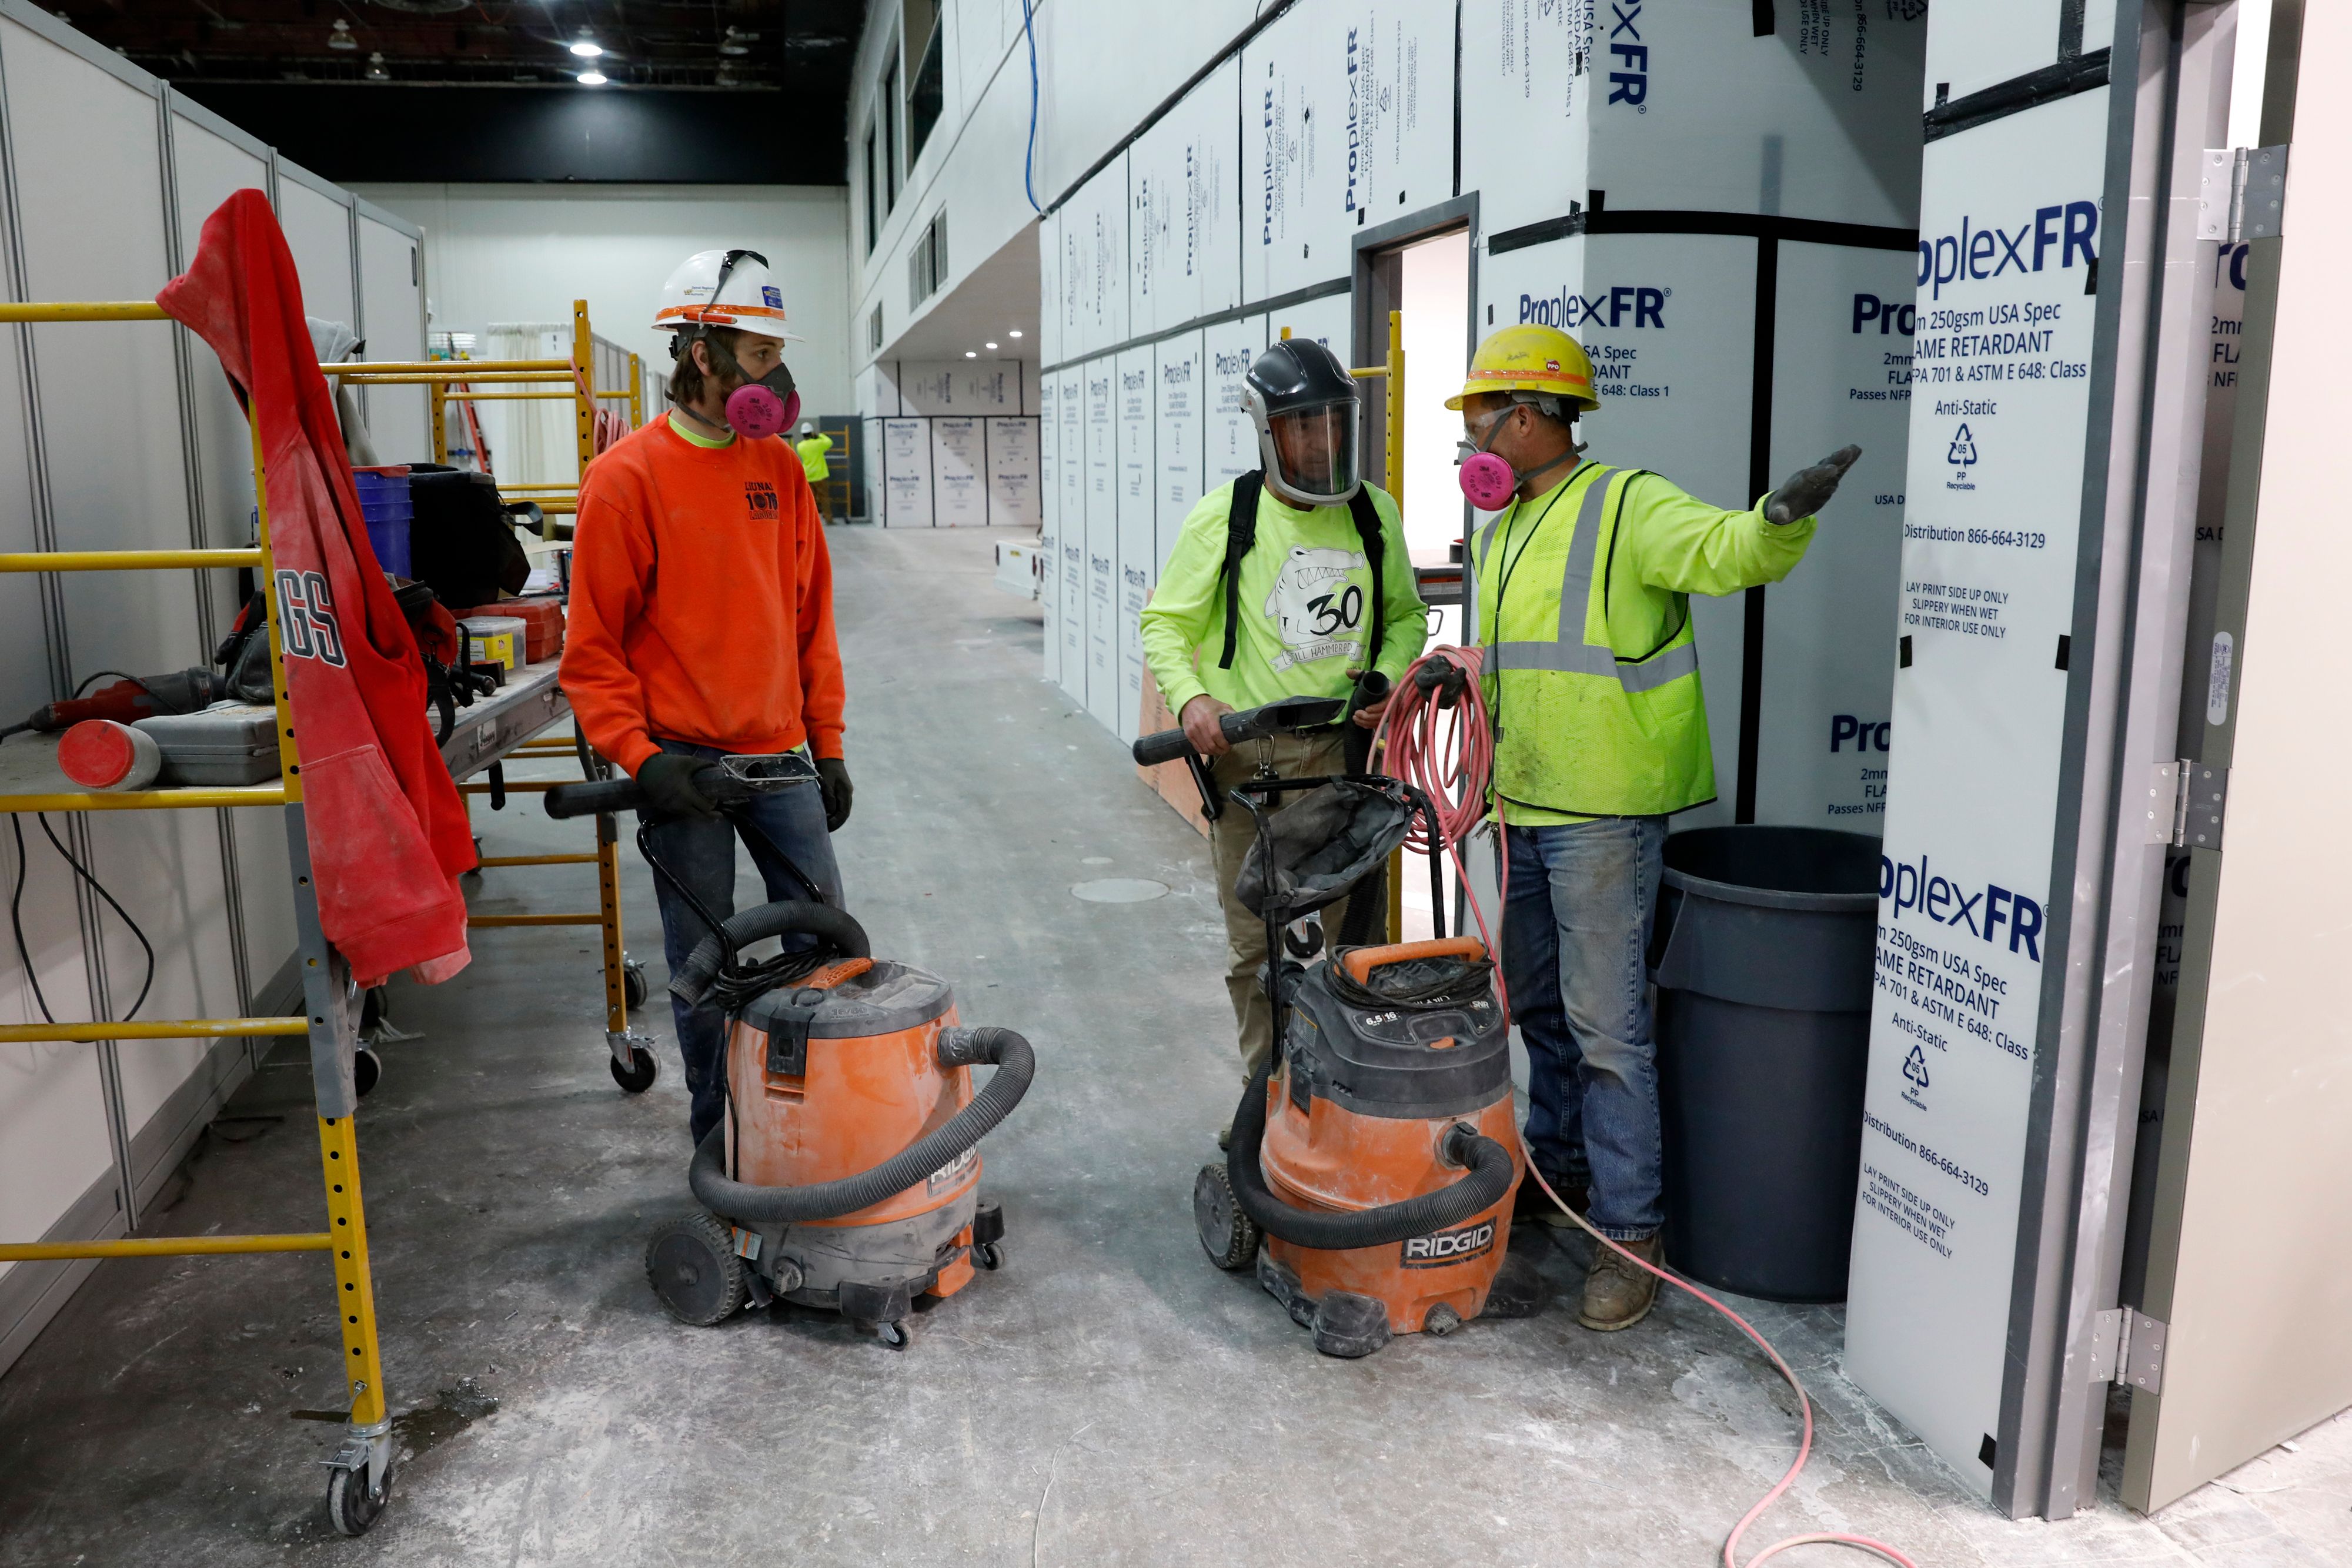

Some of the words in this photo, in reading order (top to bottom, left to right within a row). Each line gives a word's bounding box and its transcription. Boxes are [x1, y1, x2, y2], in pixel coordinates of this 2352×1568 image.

[1801, 11, 1810, 26] USE
[1823, 16, 1830, 27] UP
[1800, 28, 1809, 55] ONLY
[1810, 26, 1819, 46] WET
[1821, 29, 1830, 56] ONLY
[1583, 36, 1594, 74] Spec
[1853, 14, 1867, 92] 866-664-3129
[1566, 73, 1574, 108] Class
[1930, 310, 1983, 333] 250gsm
[1989, 304, 2019, 325] USA
[2024, 302, 2061, 327] Spec
[1604, 346, 1637, 363] Spec
[1916, 338, 1946, 359] AME
[1951, 330, 2053, 357] RETARDANT
[1888, 370, 1913, 385] FLA
[1932, 367, 1950, 382] 701
[1956, 366, 1964, 382] &
[1967, 364, 2003, 381] ASTM
[2007, 363, 2014, 380] E
[2019, 362, 2046, 379] 648:
[2050, 360, 2086, 378] Class
[1602, 384, 1626, 396] 648:
[1630, 385, 1660, 396] Class
[1664, 386, 1669, 397] 1
[1850, 389, 1887, 400] Passes
[1889, 390, 1912, 400] NFP
[1935, 399, 1996, 415] Anti-Static
[1947, 482, 1975, 491] Recyclable
[1957, 472, 1966, 480] PP
[1875, 494, 1895, 504] USA
[1968, 529, 2045, 549] 866-664-3129
[1906, 581, 1920, 593] LAY
[1923, 583, 1947, 596] PRINT
[1949, 587, 1967, 599] SIDE
[1969, 589, 1981, 600] UP
[1983, 591, 2008, 604] ONLY
[1307, 584, 1362, 636] 30
[1913, 599, 1949, 613] SLIPPERY
[1951, 603, 1977, 617] WHEN
[1980, 607, 1998, 620] WET
[1905, 613, 1920, 626] FOR
[1922, 616, 1960, 631] INTERIOR
[1963, 621, 1979, 634] USE
[1981, 624, 2006, 638] ONLY
[1828, 804, 1863, 815] Passes
[1890, 928, 1938, 964] 250gsm
[1943, 951, 1969, 978] USA
[1974, 965, 2007, 995] Spec
[1876, 946, 1903, 975] AME
[1908, 961, 1999, 1019] RETARDANT
[1472, 1001, 1490, 1009] SNR
[1365, 1014, 1383, 1025] 6.5
[1385, 1011, 1396, 1020] 16
[1890, 979, 1907, 999] 701
[1911, 990, 1919, 1007] &
[1922, 997, 1954, 1023] ASTM
[1958, 1012, 1965, 1028] E
[1967, 1018, 1992, 1042] 648:
[1996, 1032, 2028, 1060] Class
[1892, 1012, 1947, 1052] Anti-Static
[1902, 1091, 1927, 1111] Recyclable
[1910, 1087, 1919, 1097] PP
[1919, 1145, 1988, 1196] 866-664-3129
[1865, 1163, 1877, 1178] LAY
[1879, 1172, 1900, 1193] PRINT
[1902, 1188, 1918, 1206] SIDE
[1920, 1199, 1930, 1213] UP
[1933, 1209, 1955, 1229] ONLY
[1870, 1182, 1902, 1209] SLIPPERY
[1904, 1204, 1926, 1228] WHEN
[1929, 1221, 1946, 1239] WET
[1863, 1191, 1876, 1208] FOR
[1878, 1202, 1911, 1233] INTERIOR
[1914, 1226, 1927, 1243] USE
[1930, 1238, 1952, 1259] ONLY
[1407, 1223, 1492, 1257] RIDGID
